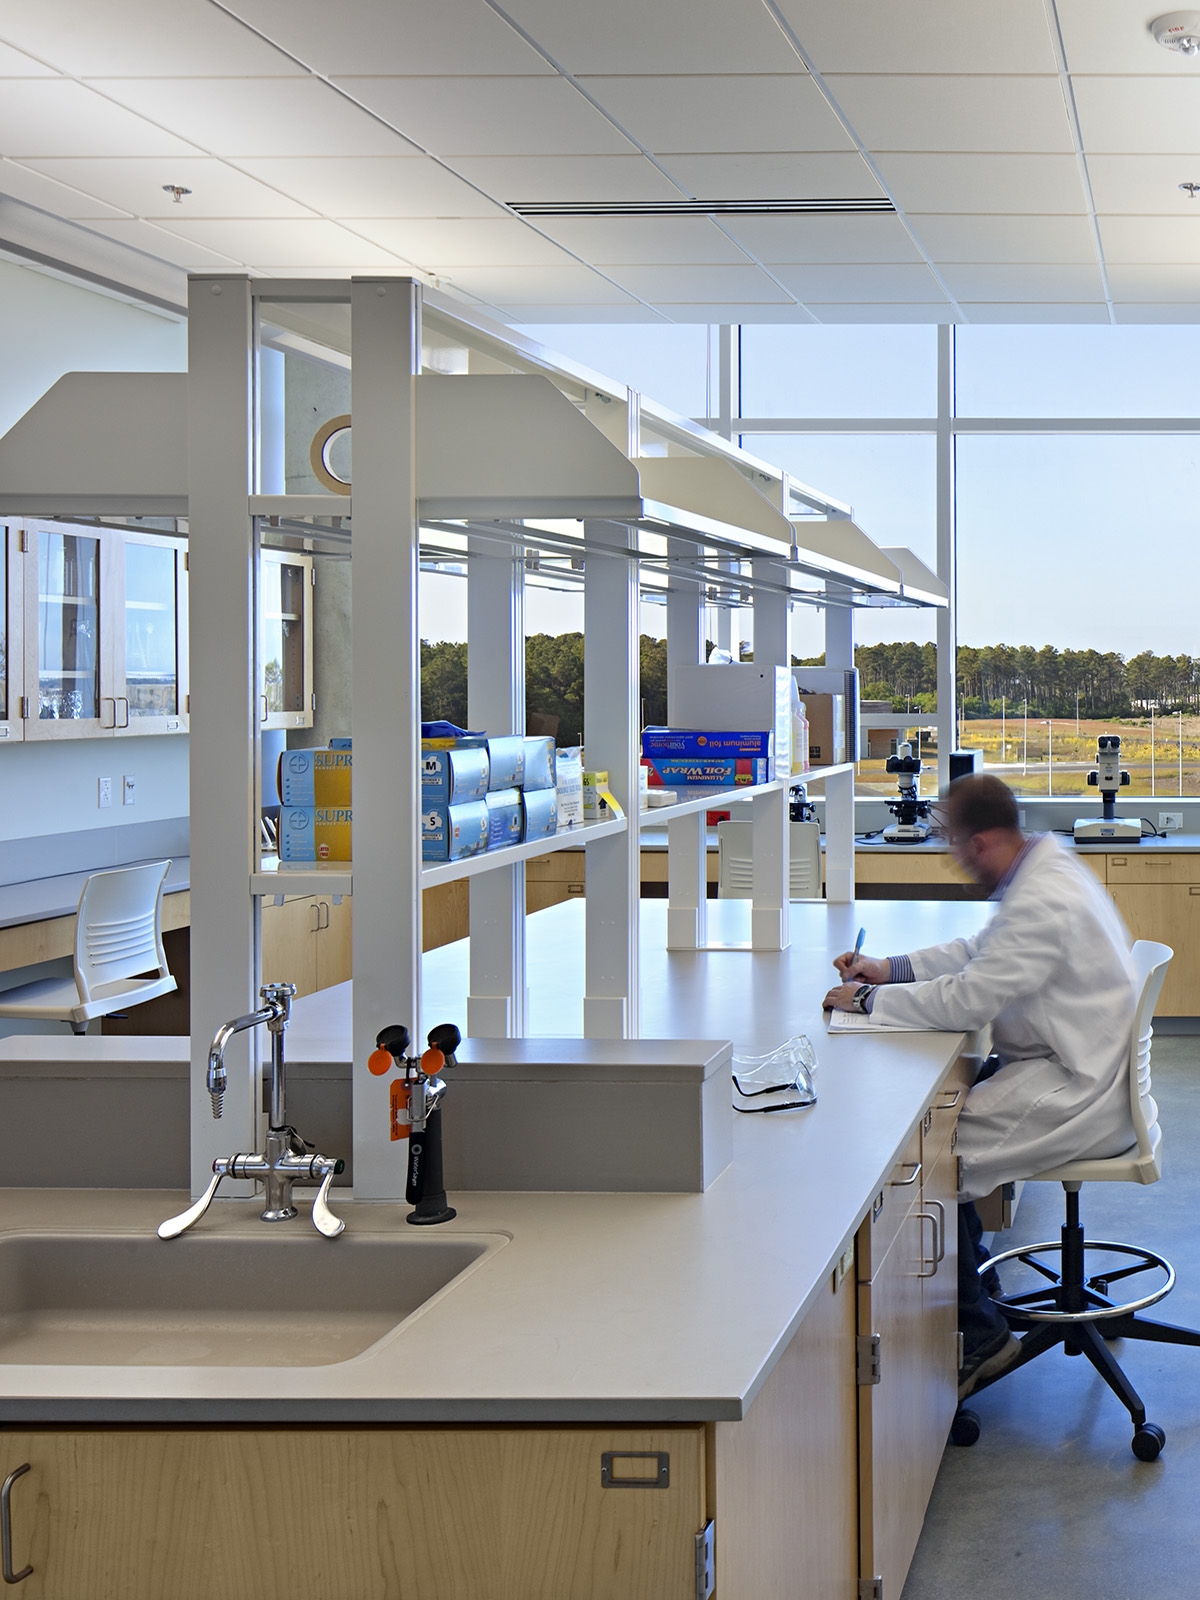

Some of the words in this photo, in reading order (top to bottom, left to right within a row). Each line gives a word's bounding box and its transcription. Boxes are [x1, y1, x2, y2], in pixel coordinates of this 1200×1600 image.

[723, 740, 761, 748] aluminum
[425, 761, 437, 771] M
[662, 766, 703, 775] WRAP
[703, 766, 732, 775] FOIL
[430, 817, 436, 826] S
